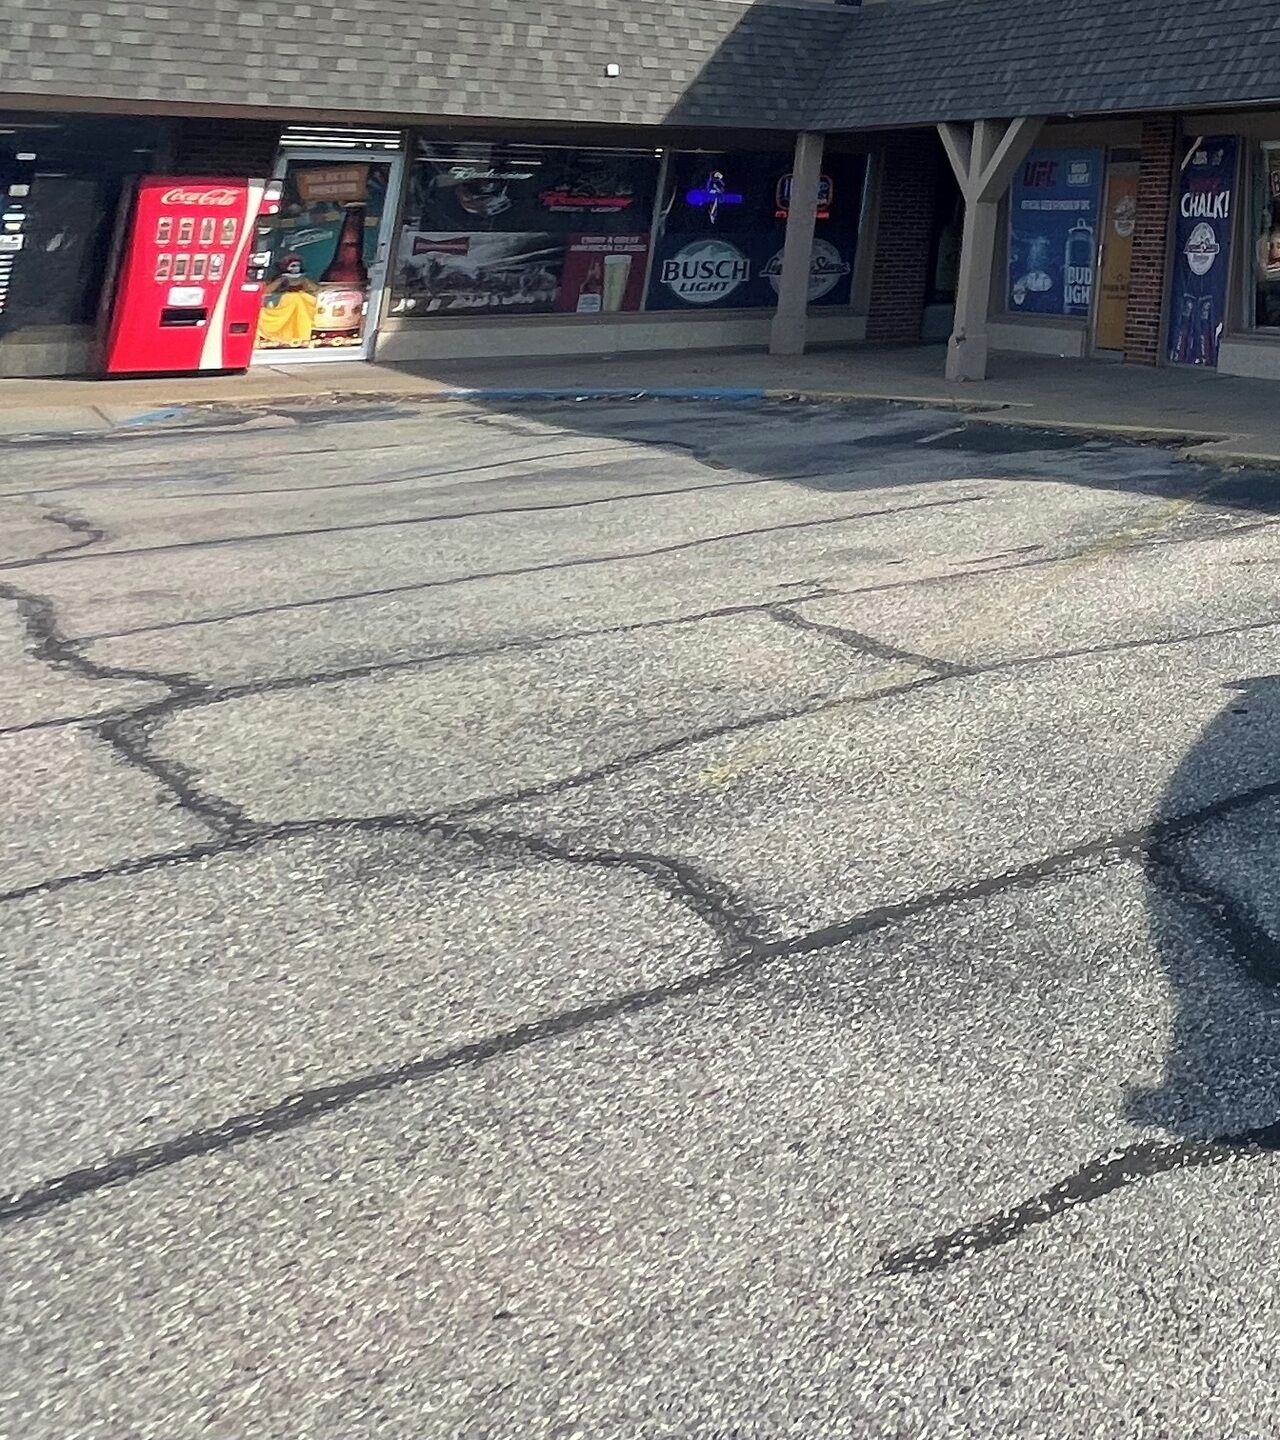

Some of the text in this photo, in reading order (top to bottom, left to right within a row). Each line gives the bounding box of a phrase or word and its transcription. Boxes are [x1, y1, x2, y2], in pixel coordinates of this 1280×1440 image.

[1180, 190, 1230, 219] CHALK!
[663, 260, 749, 281] BUSCH
[1066, 266, 1093, 285] BUD
[679, 281, 730, 292] LIGHT
[1064, 285, 1090, 304] LIGH
